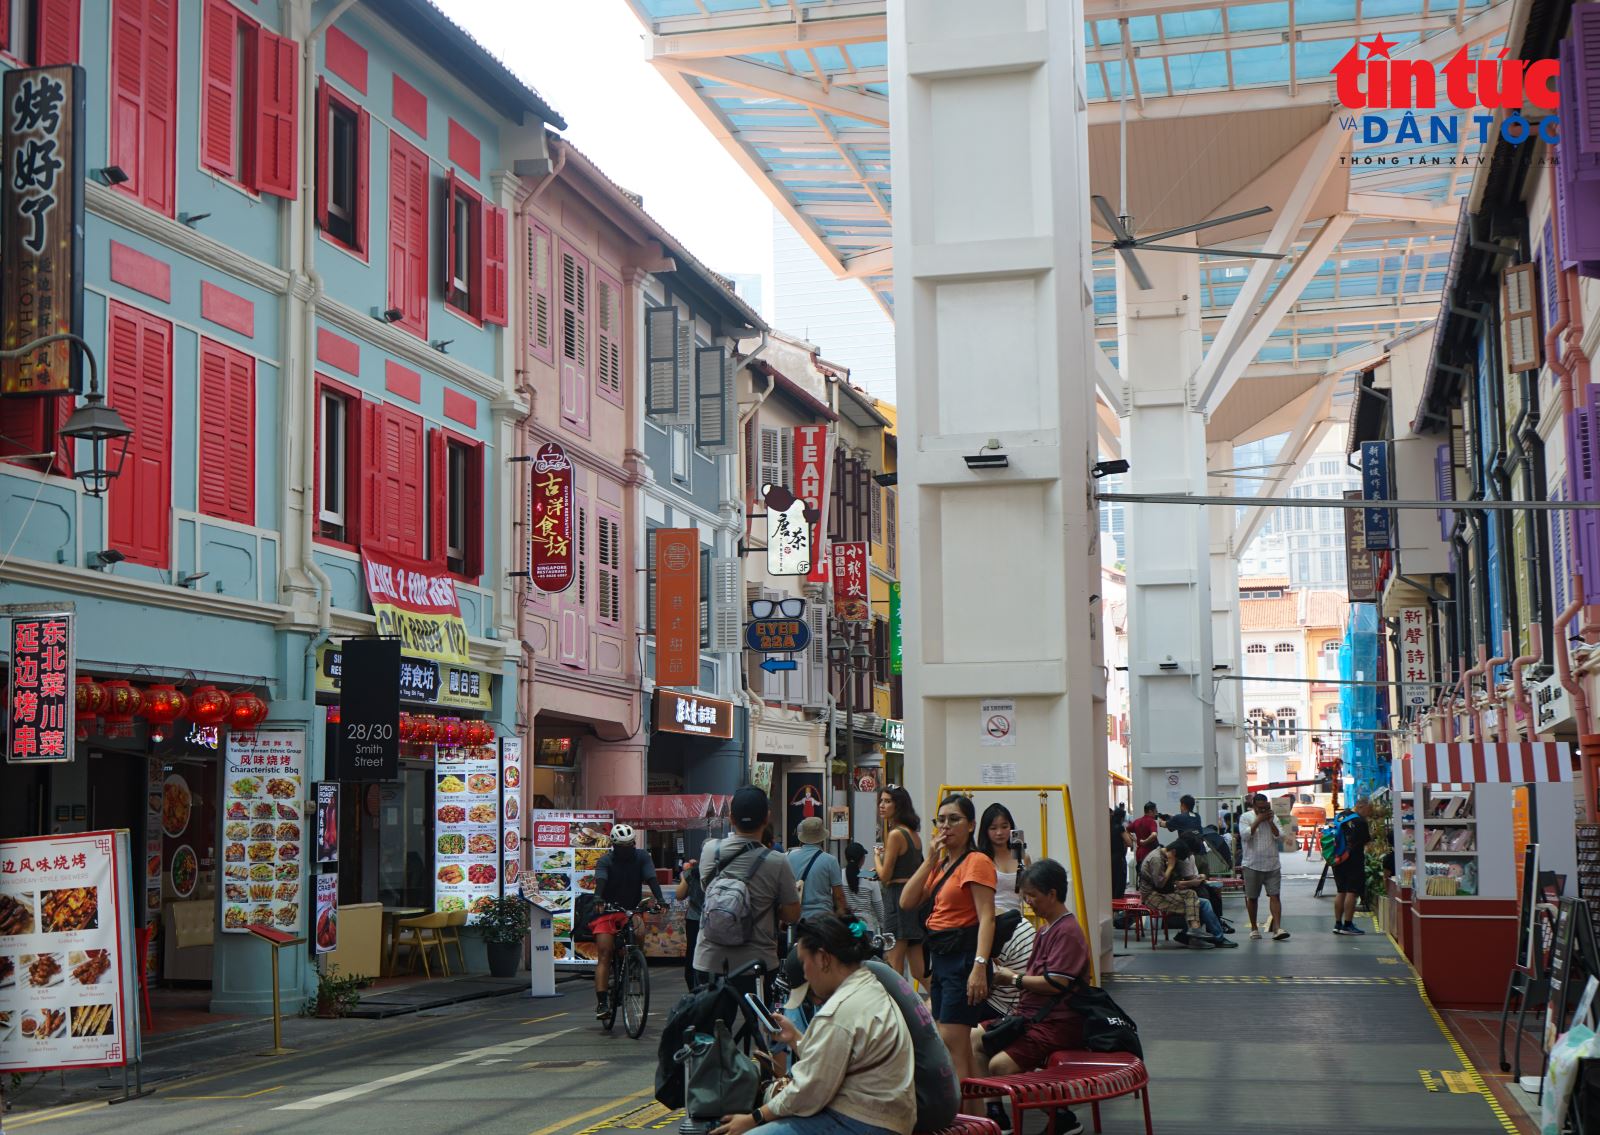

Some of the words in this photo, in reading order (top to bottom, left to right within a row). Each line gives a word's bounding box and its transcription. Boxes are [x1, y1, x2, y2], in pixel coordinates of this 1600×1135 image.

[14, 76, 64, 251] 烤好了
[536, 472, 569, 557] 古洋食坊
[771, 513, 807, 551] 唐茶
[799, 563, 809, 572] 3F
[367, 560, 399, 599] LEVEL
[397, 568, 407, 602] 2
[407, 571, 431, 606] FOR
[429, 576, 457, 608] RENT
[378, 610, 412, 650] CALL
[761, 635, 796, 649] 22A
[1404, 609, 1427, 683] 新聲詩社
[13, 622, 39, 758] 延边烤串
[449, 671, 480, 695] 融合菜
[347, 724, 393, 741] 28/30
[240, 754, 292, 766] 风味烧烤
[356, 744, 383, 754] Smith
[230, 766, 281, 774] Characteristic
[284, 766, 299, 775] Bbq
[354, 757, 384, 767] Street
